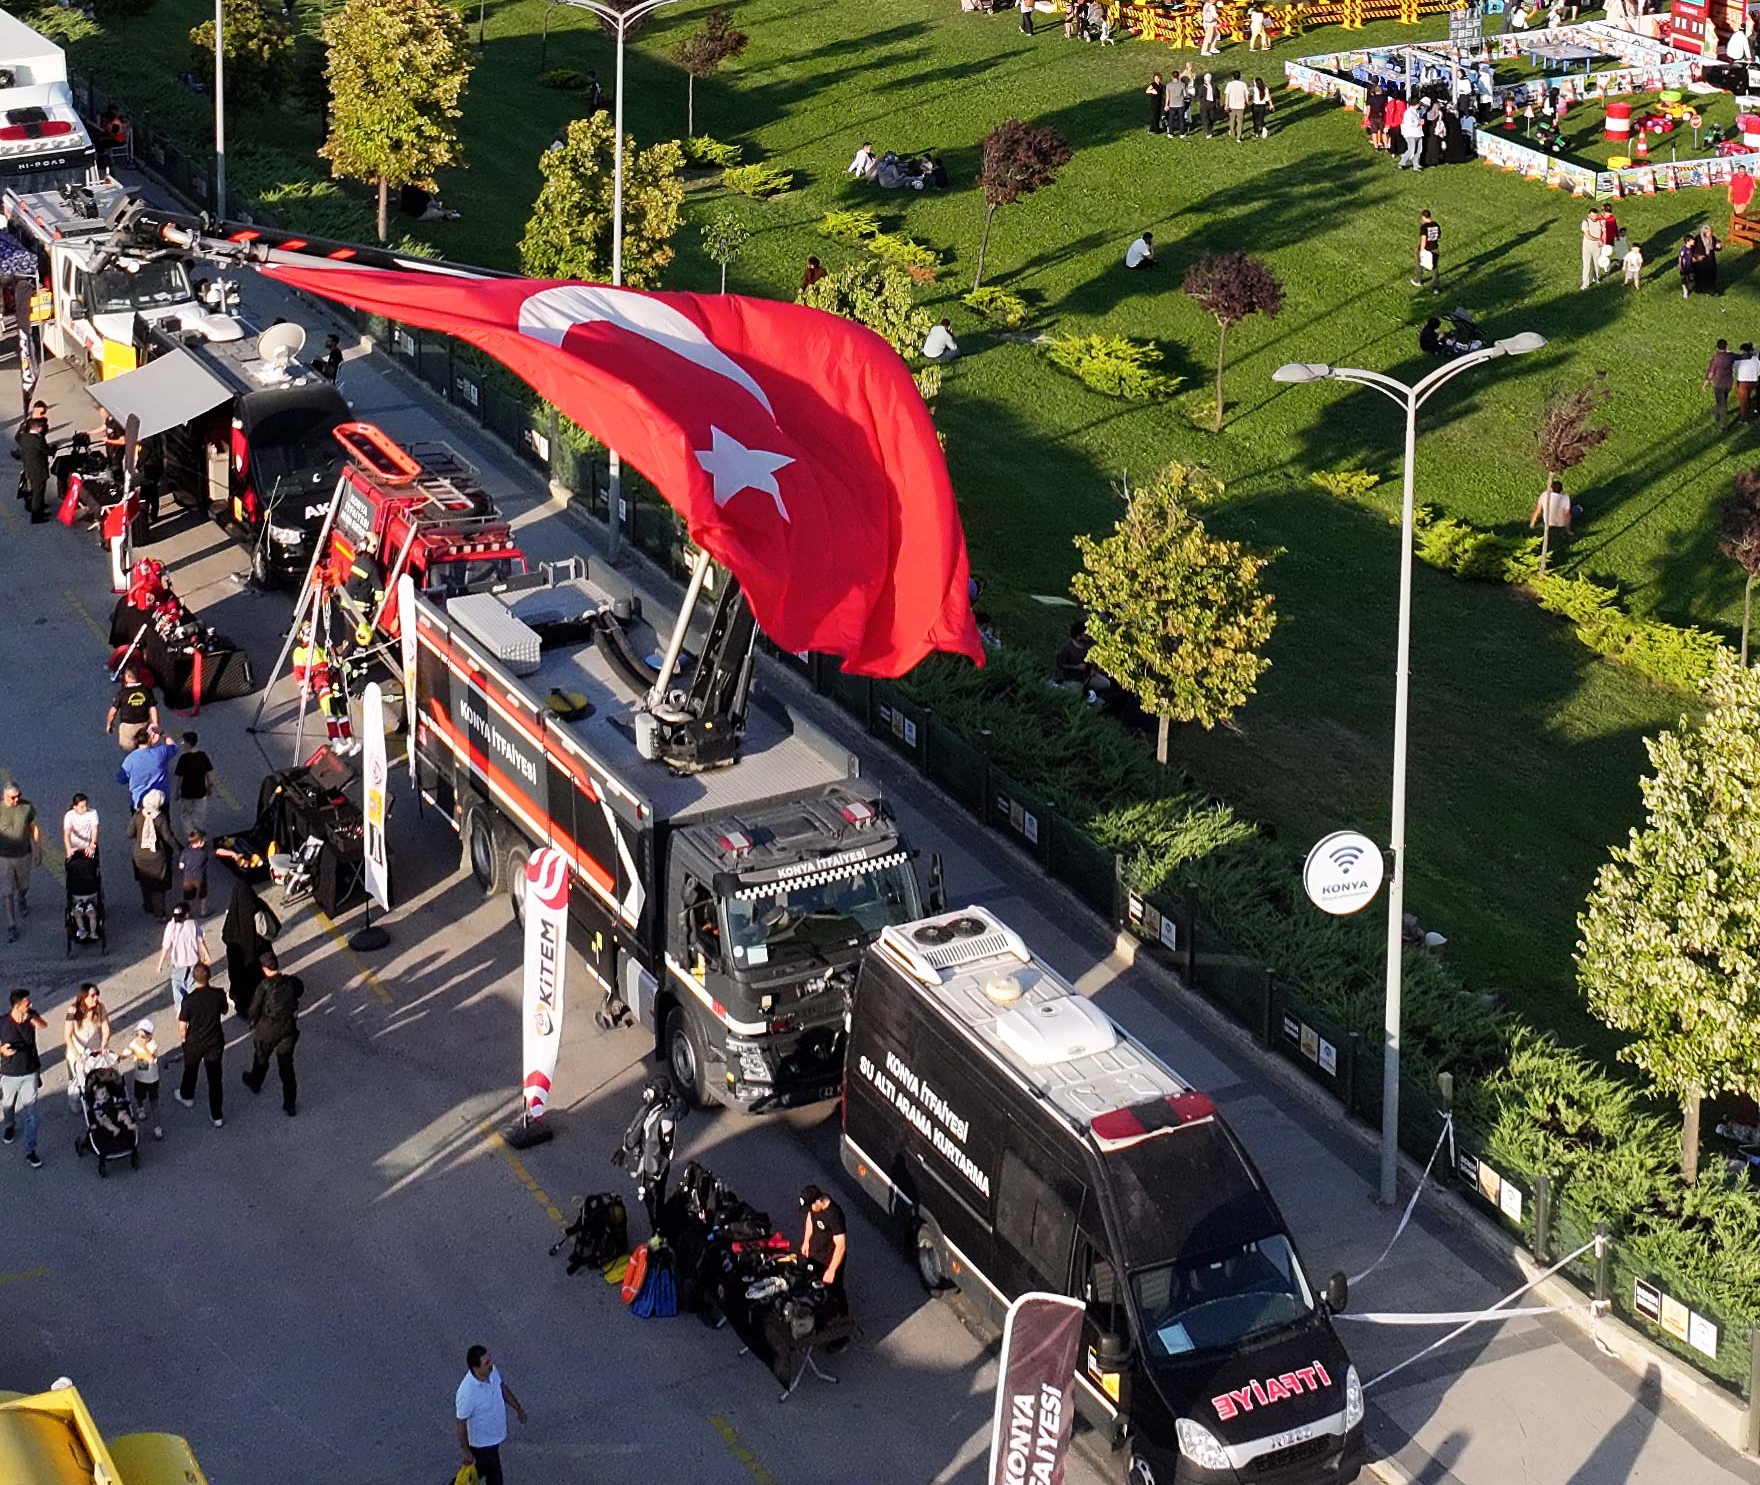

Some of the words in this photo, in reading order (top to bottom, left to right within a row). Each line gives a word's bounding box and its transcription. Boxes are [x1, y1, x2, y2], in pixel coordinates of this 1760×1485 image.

[459, 699, 491, 743] KONYA
[492, 726, 537, 785] İTFAİYESİ
[777, 861, 815, 879] KONYA
[816, 848, 867, 870] İTFAİYESİ
[1322, 880, 1369, 895] KONYA
[859, 1055, 875, 1082] SU
[874, 1070, 897, 1103] ALTI
[895, 1092, 933, 1140] ARAMA
[932, 1126, 991, 1198] KURTARMA
[886, 1051, 920, 1098] KONYA
[920, 1080, 970, 1144] İTFAİYESİ
